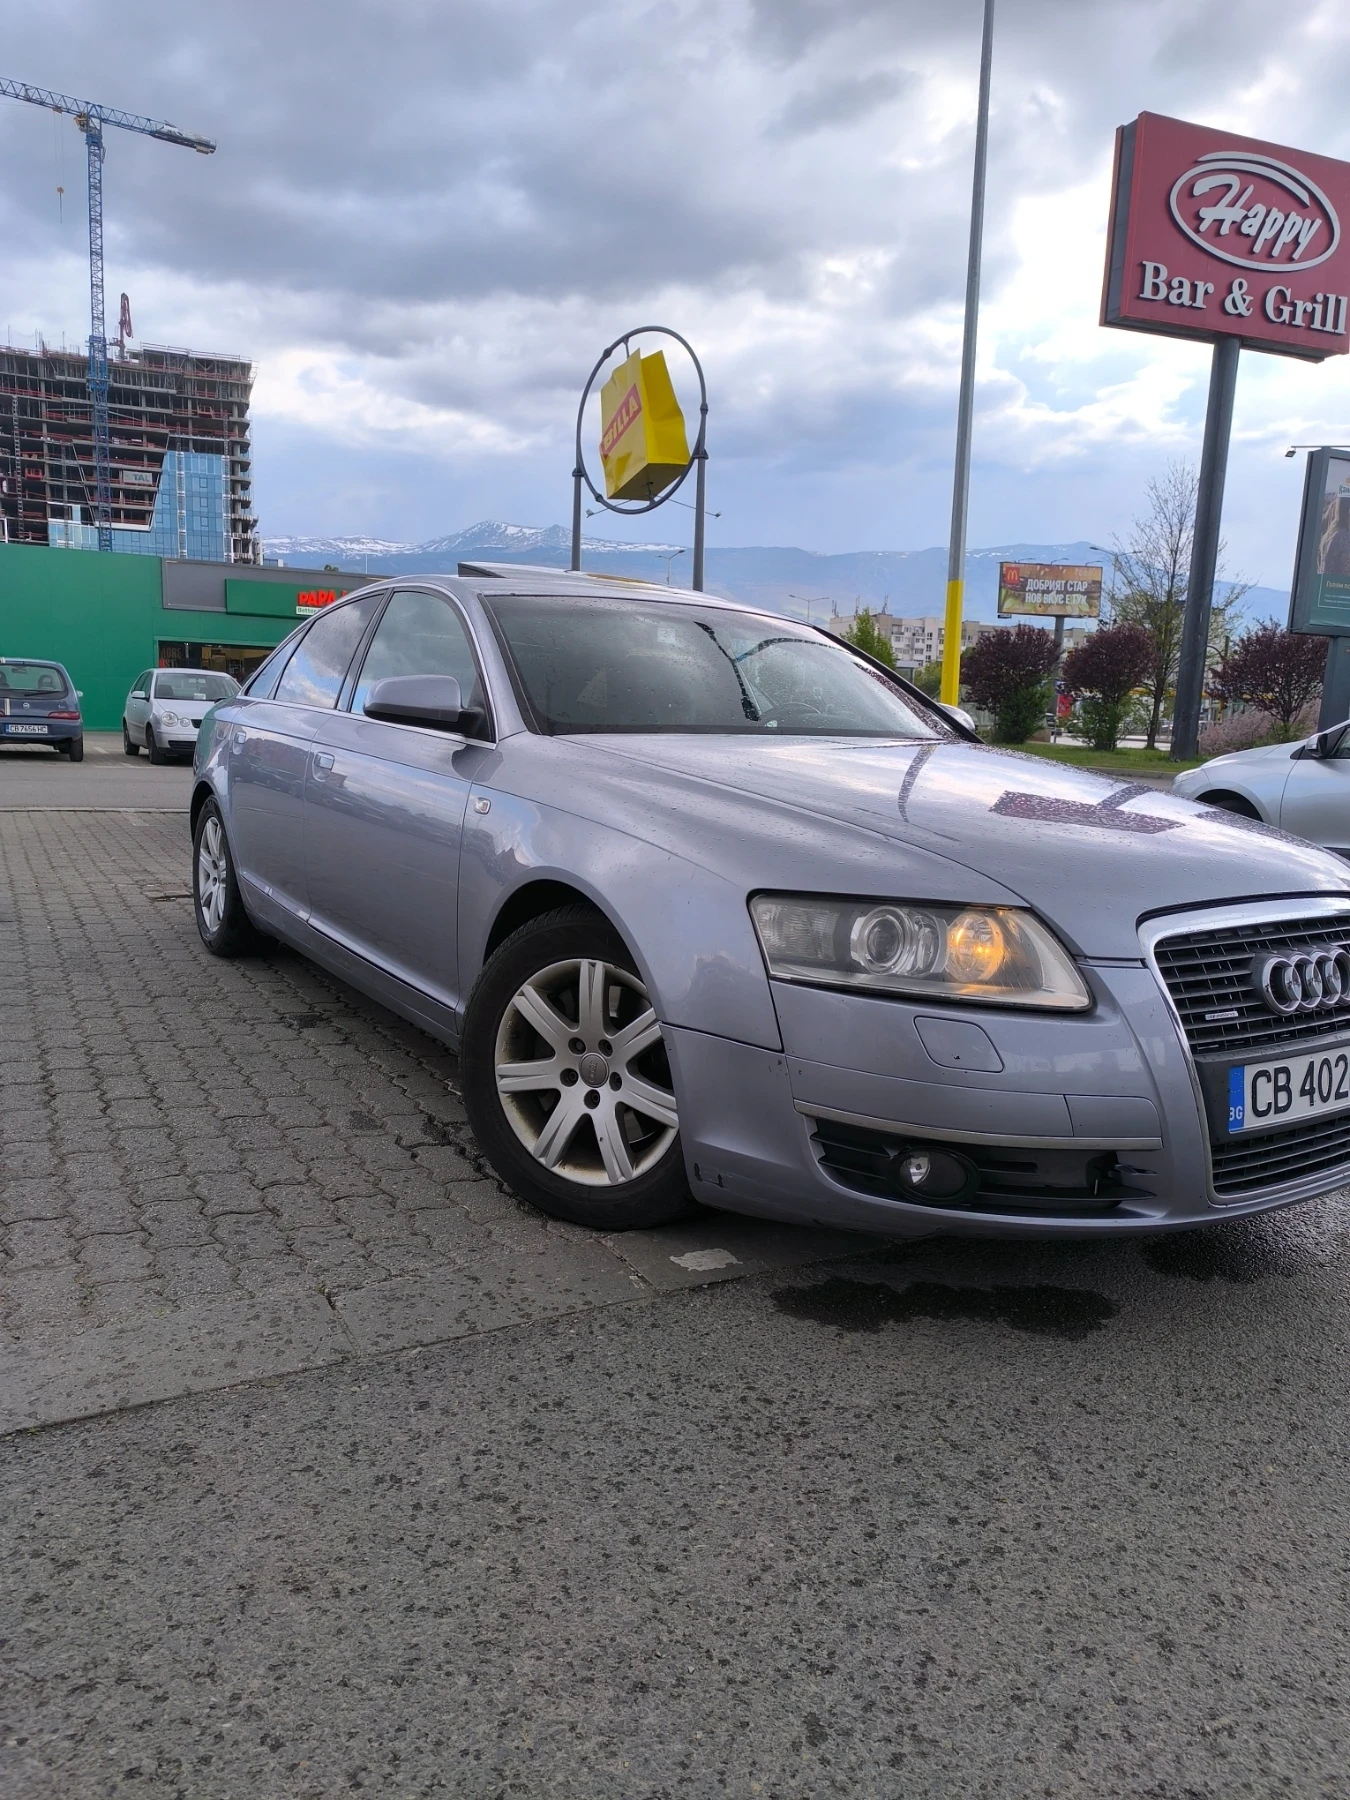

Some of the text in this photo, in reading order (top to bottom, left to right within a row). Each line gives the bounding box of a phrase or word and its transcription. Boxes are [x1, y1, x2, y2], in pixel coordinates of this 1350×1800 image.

[1193, 174, 1322, 260] Happy
[1140, 261, 1348, 334] Bar & Grill
[603, 395, 639, 451] BILLA
[297, 589, 336, 606] PAPA
[1025, 593, 1042, 603] НОВ
[1043, 595, 1064, 605] ВКУС
[1026, 579, 1088, 592] ДОБРИЯТ СТАР
[1251, 1053, 1350, 1118] CB 402
